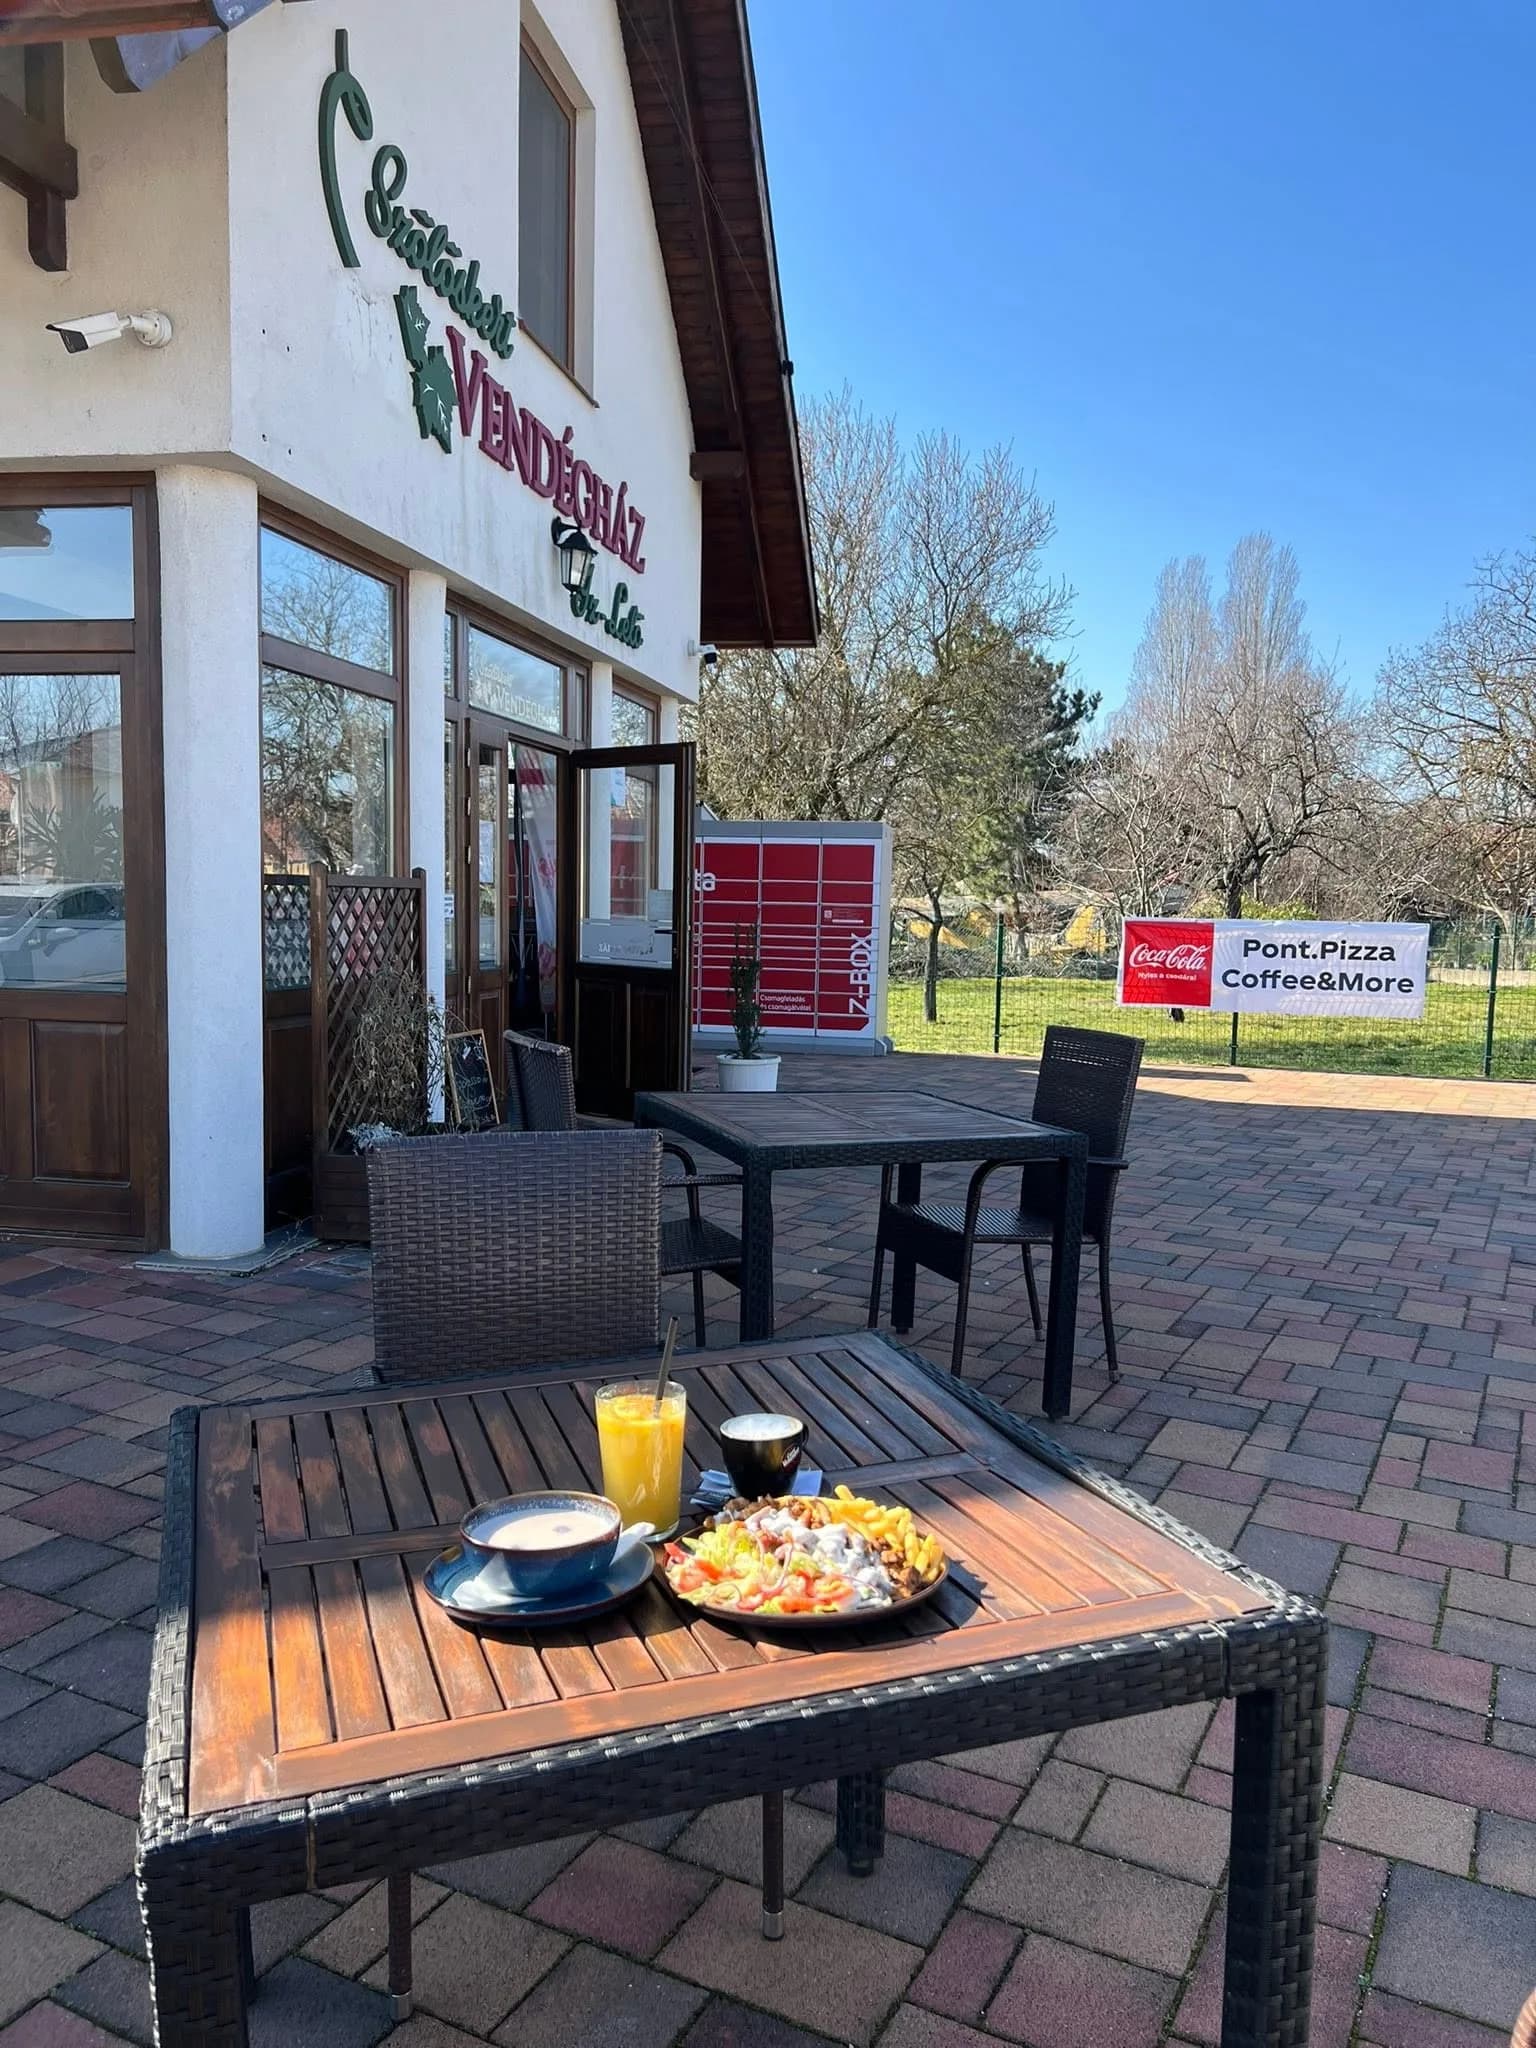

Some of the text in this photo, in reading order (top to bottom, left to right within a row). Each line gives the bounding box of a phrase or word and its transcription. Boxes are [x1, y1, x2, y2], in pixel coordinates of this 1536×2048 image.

[446, 325, 646, 574] VENDÉGHÁZ
[1129, 943, 1211, 970] Coca-Cola
[1242, 938, 1396, 962] Pont.Pizza
[848, 932, 872, 1015] Z-BOX
[1221, 968, 1415, 993] Coffee&More
